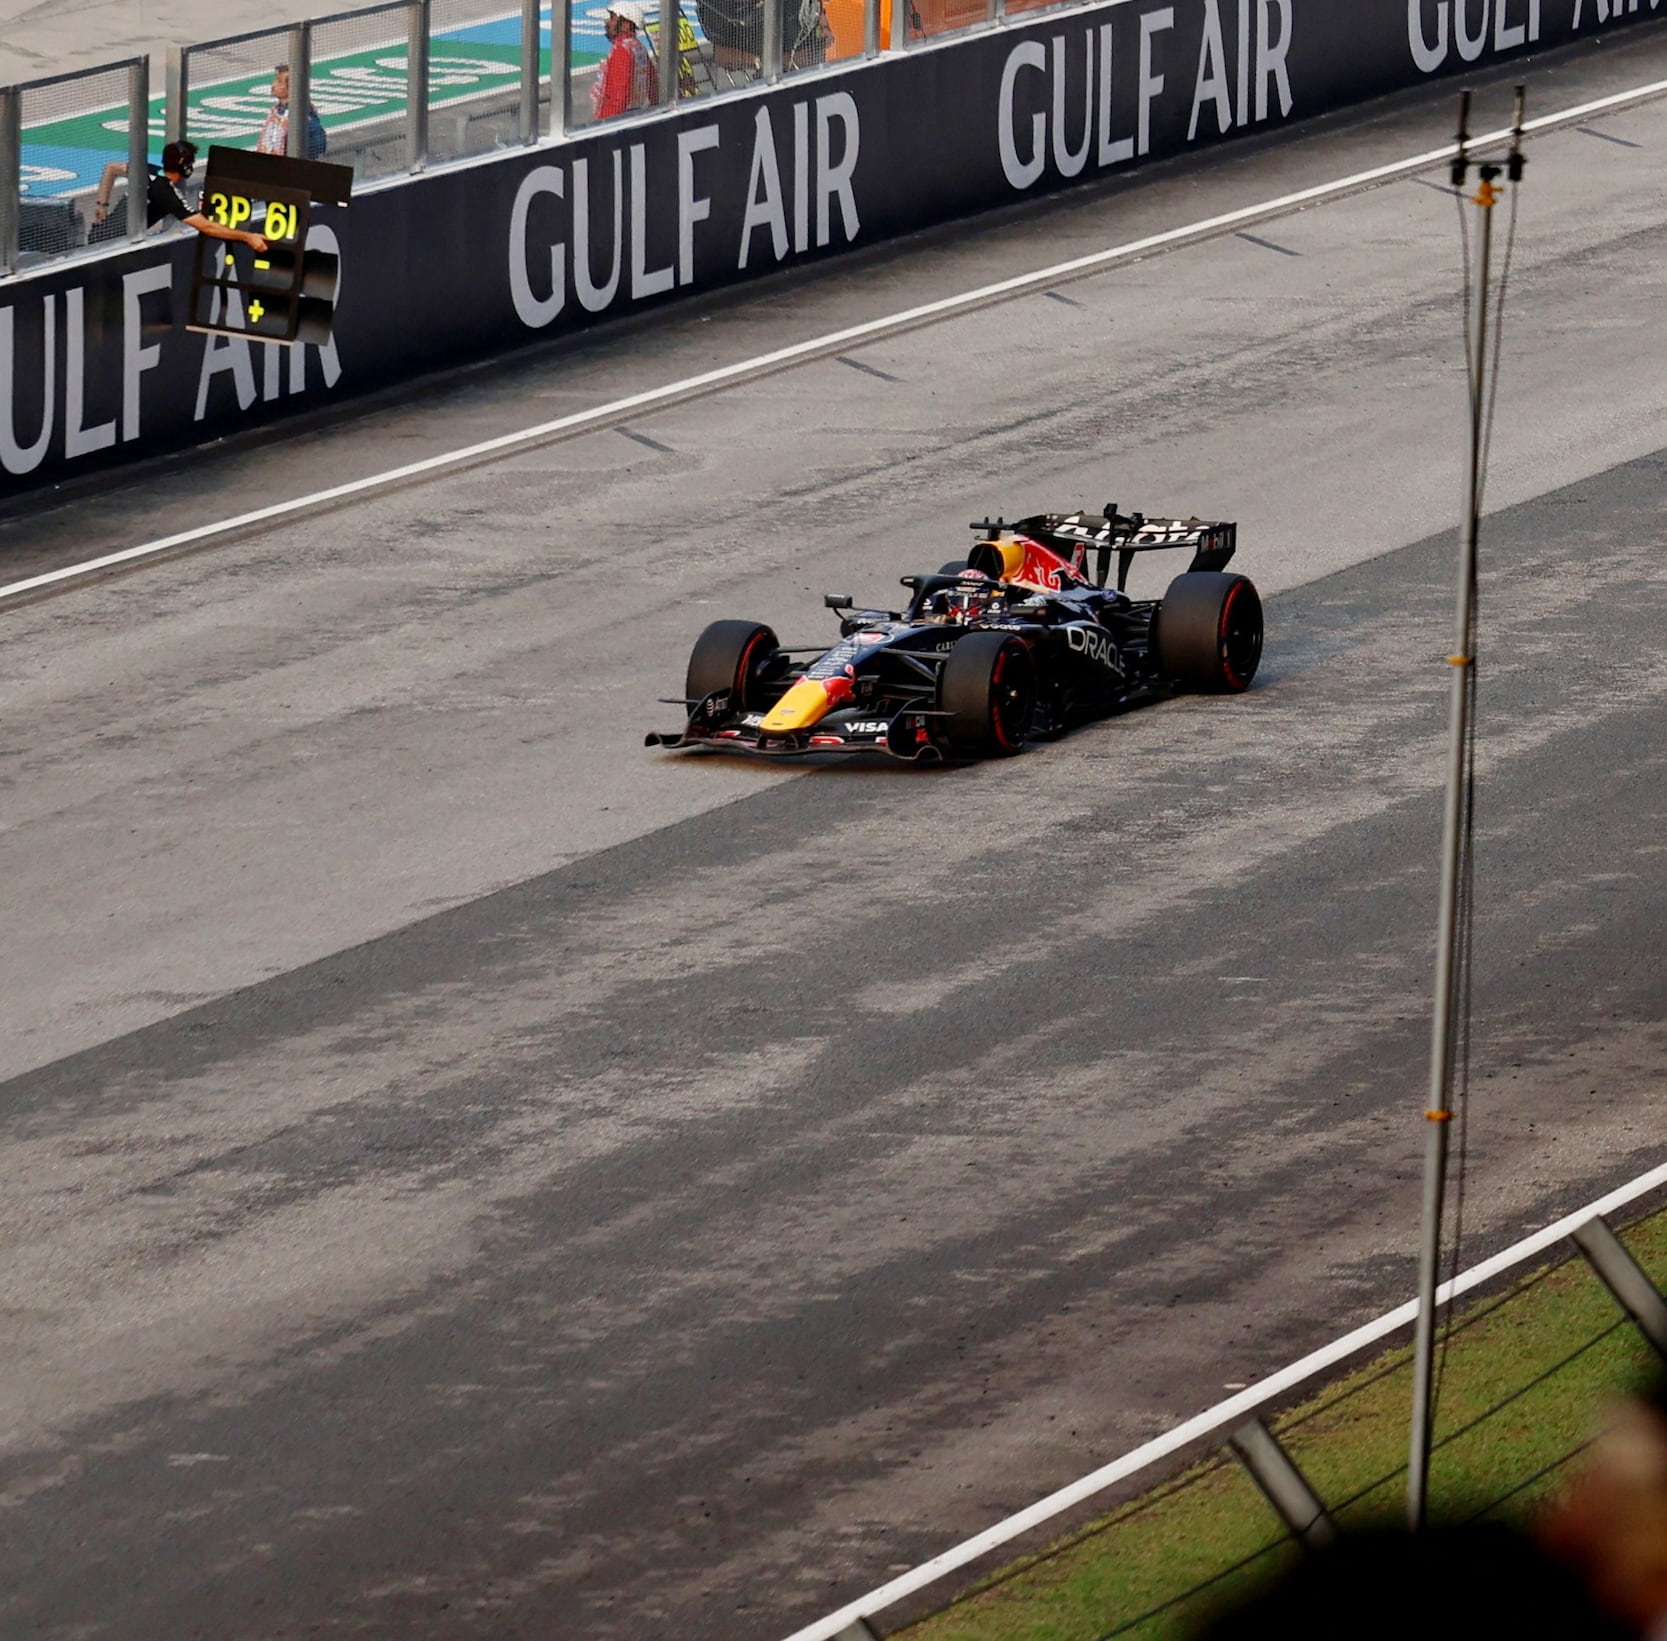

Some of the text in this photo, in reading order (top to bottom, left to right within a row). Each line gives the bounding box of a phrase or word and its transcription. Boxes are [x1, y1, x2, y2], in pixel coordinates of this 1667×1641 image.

[998, 6, 1174, 190] GULF
[508, 124, 720, 330] GULF
[737, 91, 861, 270] AIR
[844, 722, 889, 733] VISA
